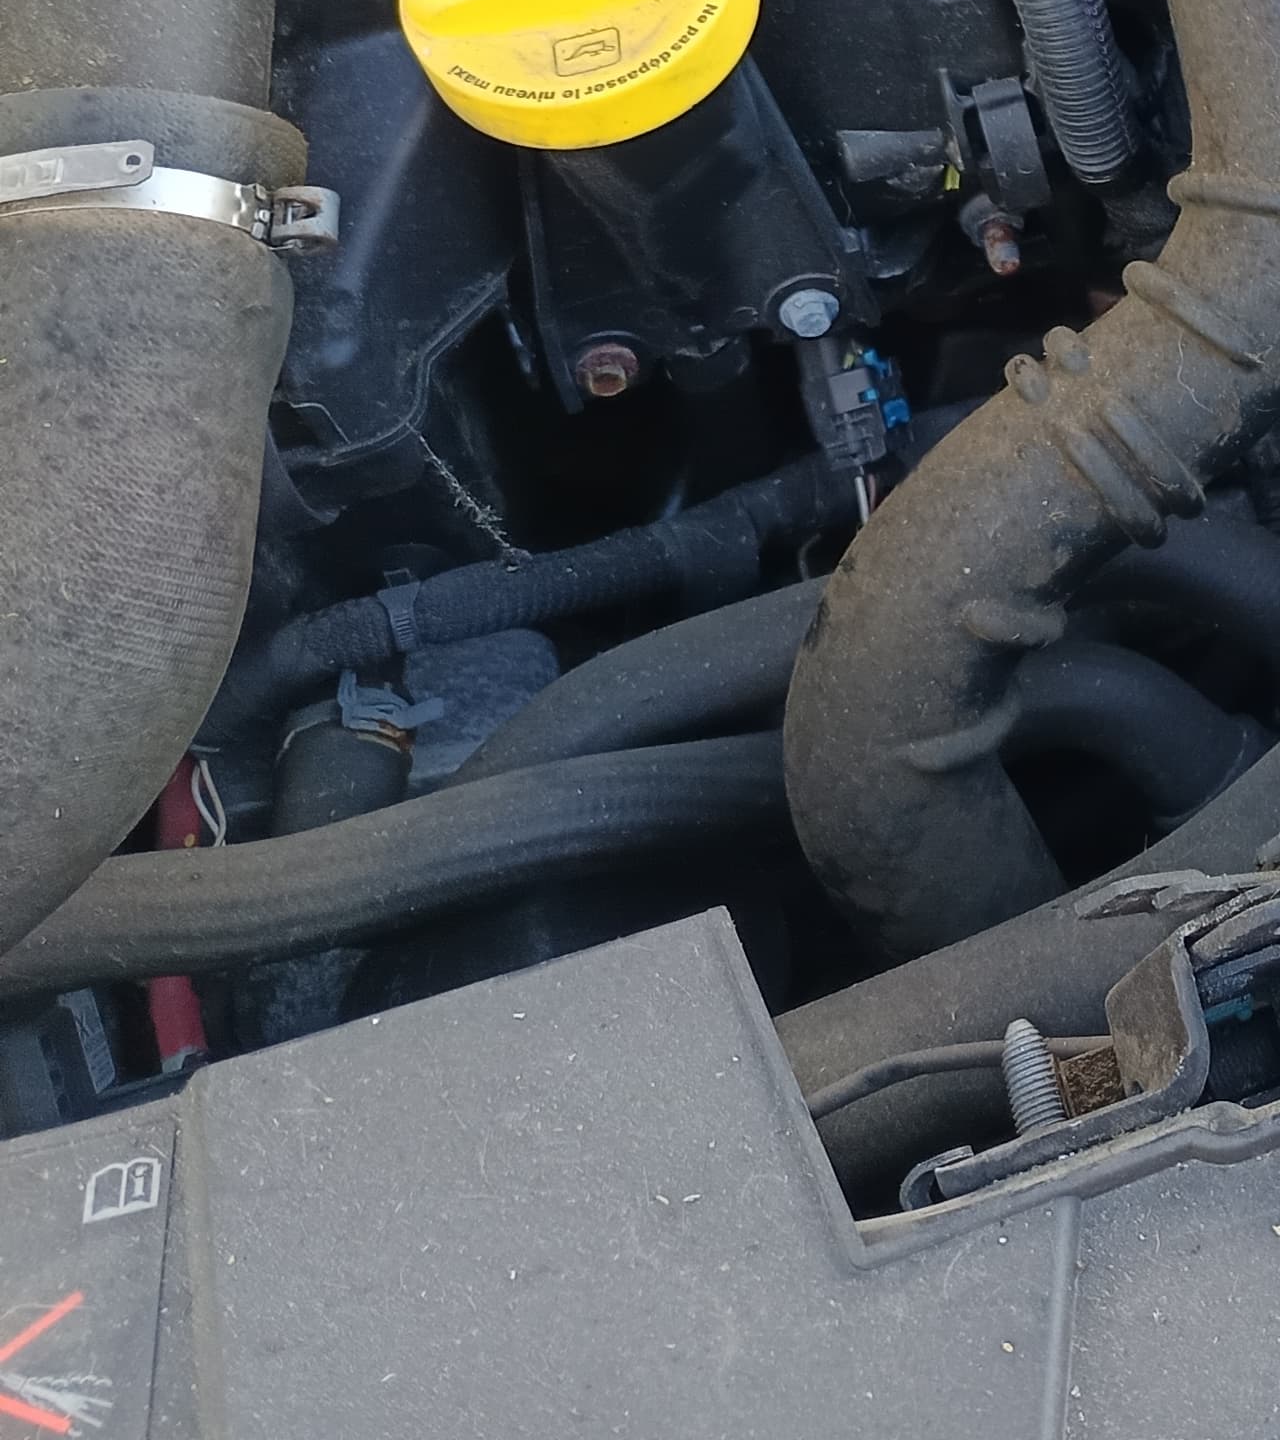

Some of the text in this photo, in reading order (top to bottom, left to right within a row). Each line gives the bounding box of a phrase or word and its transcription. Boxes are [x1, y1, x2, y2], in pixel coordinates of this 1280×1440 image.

[697, 3, 719, 24] Ne
[670, 25, 699, 52] pas
[446, 65, 491, 90] maxi
[492, 85, 556, 103] niveau
[561, 88, 580, 100] le
